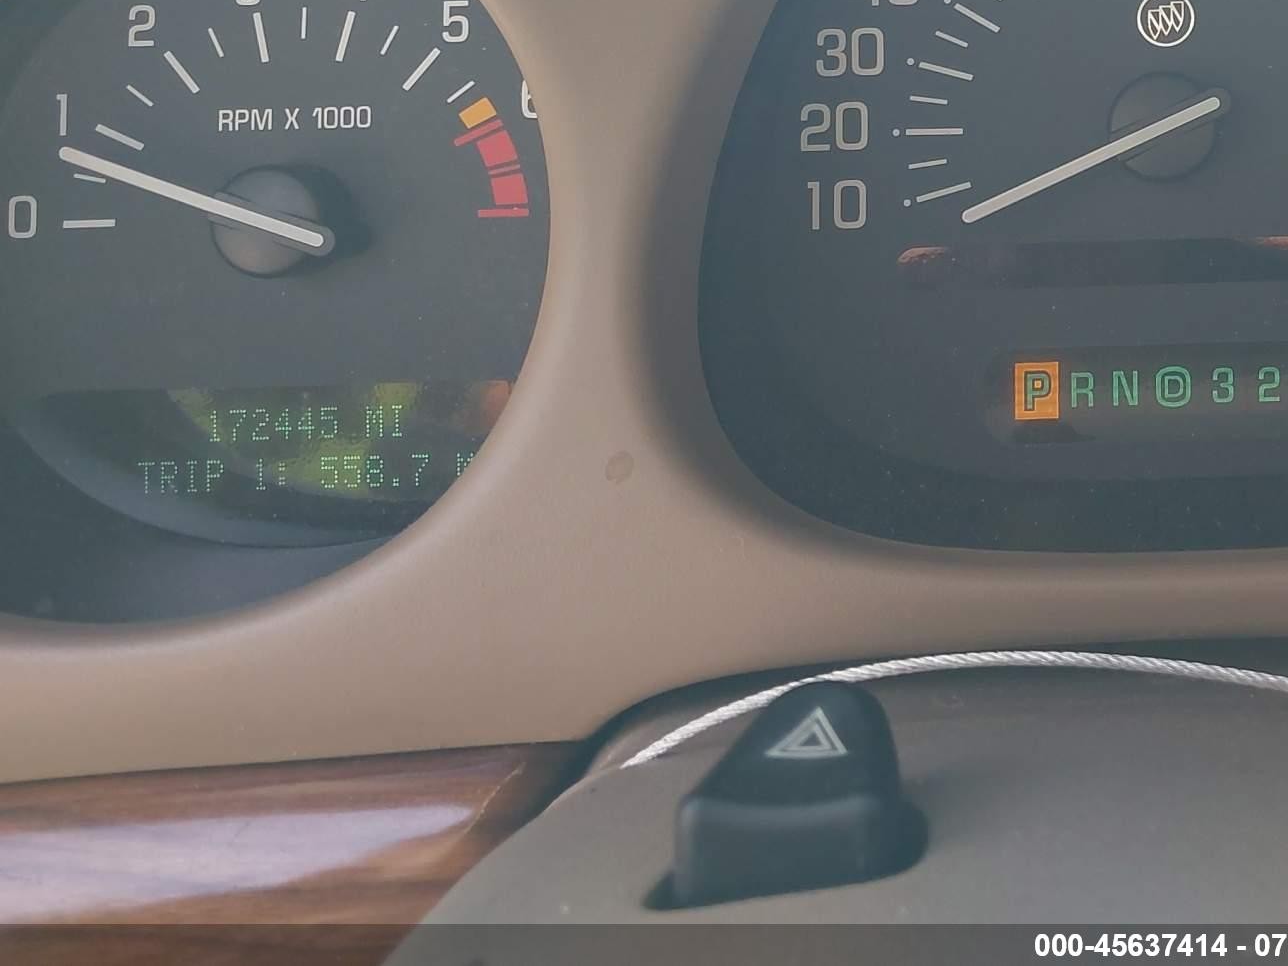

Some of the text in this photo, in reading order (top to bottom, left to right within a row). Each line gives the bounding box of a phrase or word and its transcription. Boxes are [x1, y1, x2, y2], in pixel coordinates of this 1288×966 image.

[128, 5, 155, 46] 2
[442, 0, 470, 43] 5
[817, 28, 884, 76] 30
[57, 94, 67, 136] 1
[219, 106, 371, 131] RPM X 1000
[801, 102, 868, 151] 20
[9, 196, 37, 238] 0
[808, 180, 866, 229] 10
[1024, 370, 1051, 411] P
[1070, 371, 1095, 409] R
[1112, 370, 1139, 407] N
[1212, 367, 1235, 404] 3
[1258, 366, 1281, 403] 2
[209, 404, 403, 443] 172445 MI
[137, 459, 225, 494] TRIP
[320, 452, 430, 489] 558.7
